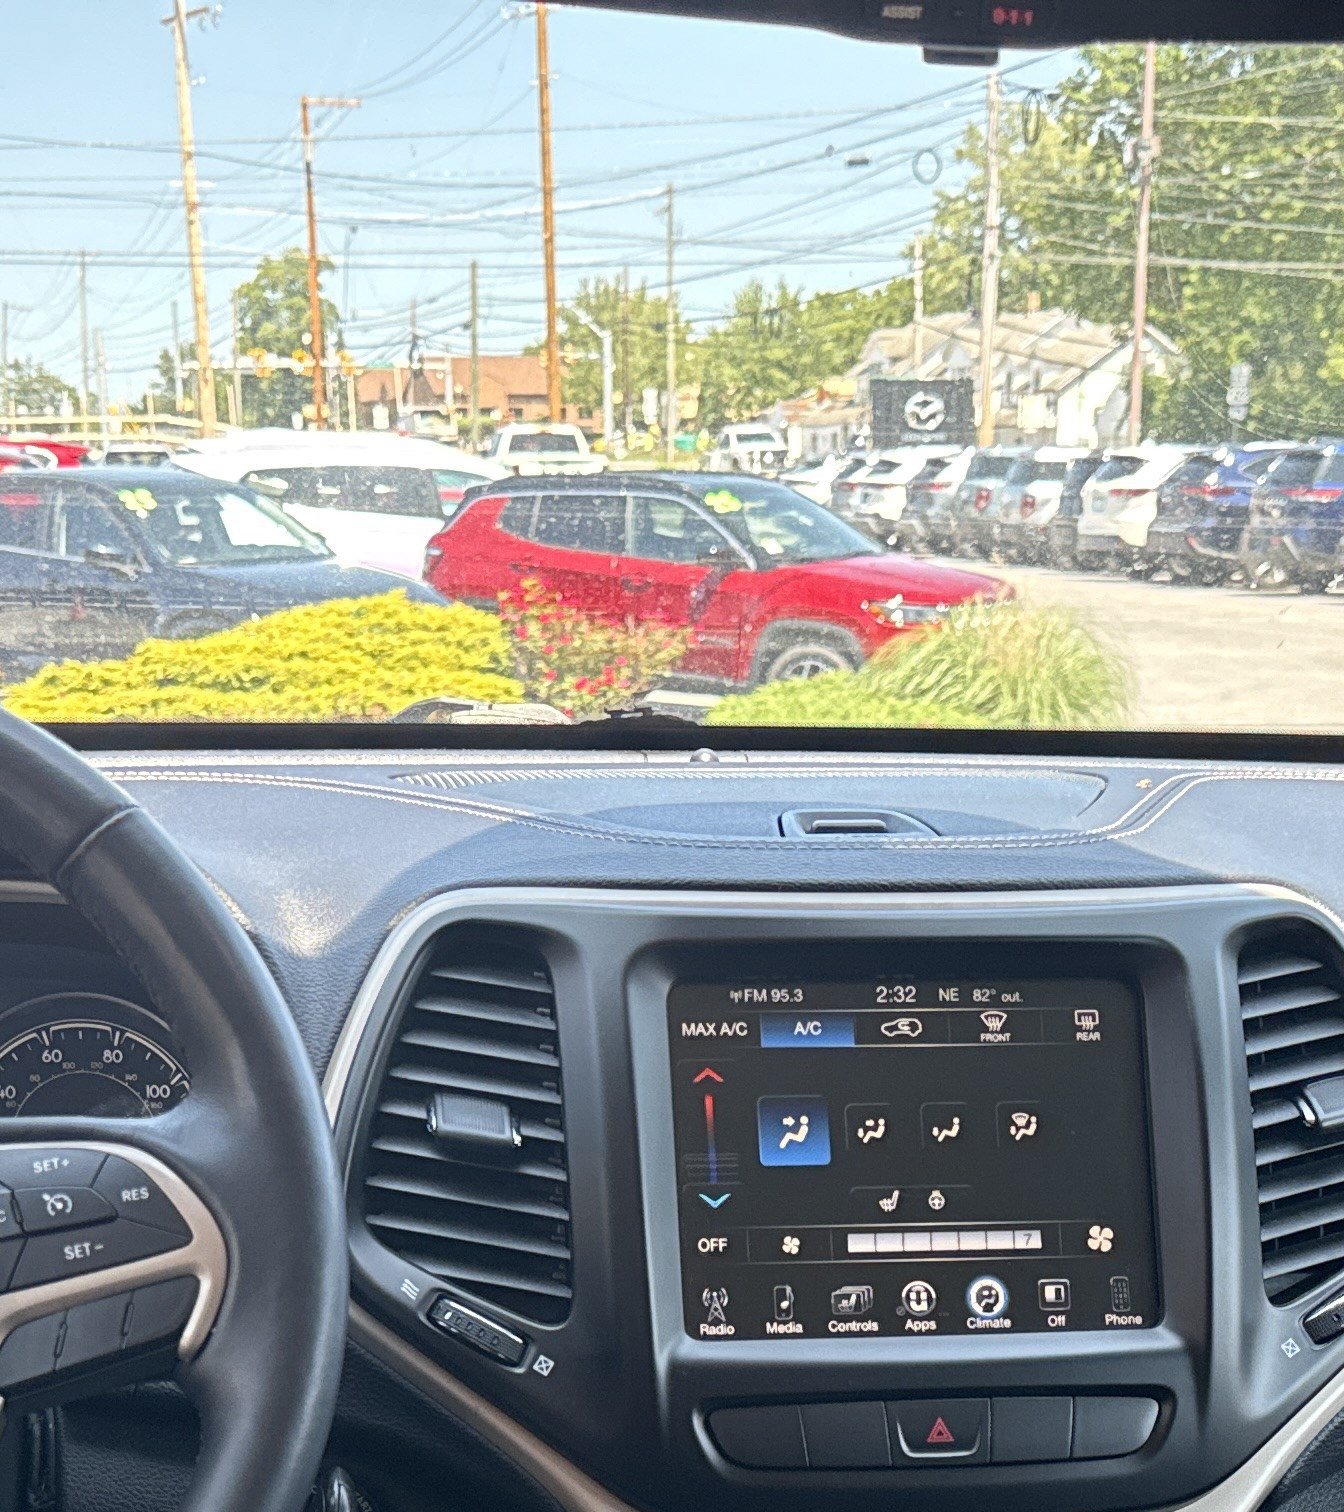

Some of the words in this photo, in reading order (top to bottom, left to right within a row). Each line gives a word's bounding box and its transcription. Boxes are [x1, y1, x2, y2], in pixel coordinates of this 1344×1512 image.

[744, 988, 767, 1003] FM
[771, 988, 804, 1003] 95.3
[875, 985, 917, 1003] 2:32
[938, 987, 960, 1002] NE
[681, 1021, 716, 1037] MAX
[719, 1021, 749, 1037] A/C
[793, 1020, 823, 1036] A/C
[980, 1032, 1011, 1042] FRONT
[1076, 1031, 1101, 1042] REAR
[41, 1050, 63, 1063] 60
[102, 1050, 123, 1063] 80
[145, 1084, 171, 1099] 100
[120, 1186, 150, 1203] RES
[697, 1237, 729, 1253] OFF
[1022, 1232, 1033, 1246] 7
[828, 1319, 880, 1333] Controls
[904, 1318, 937, 1333] Apps
[966, 1316, 1012, 1331] Climate
[1047, 1314, 1067, 1328] Off
[1104, 1313, 1143, 1327] Phone
[699, 1322, 736, 1336] Radio
[766, 1321, 804, 1335] Media
